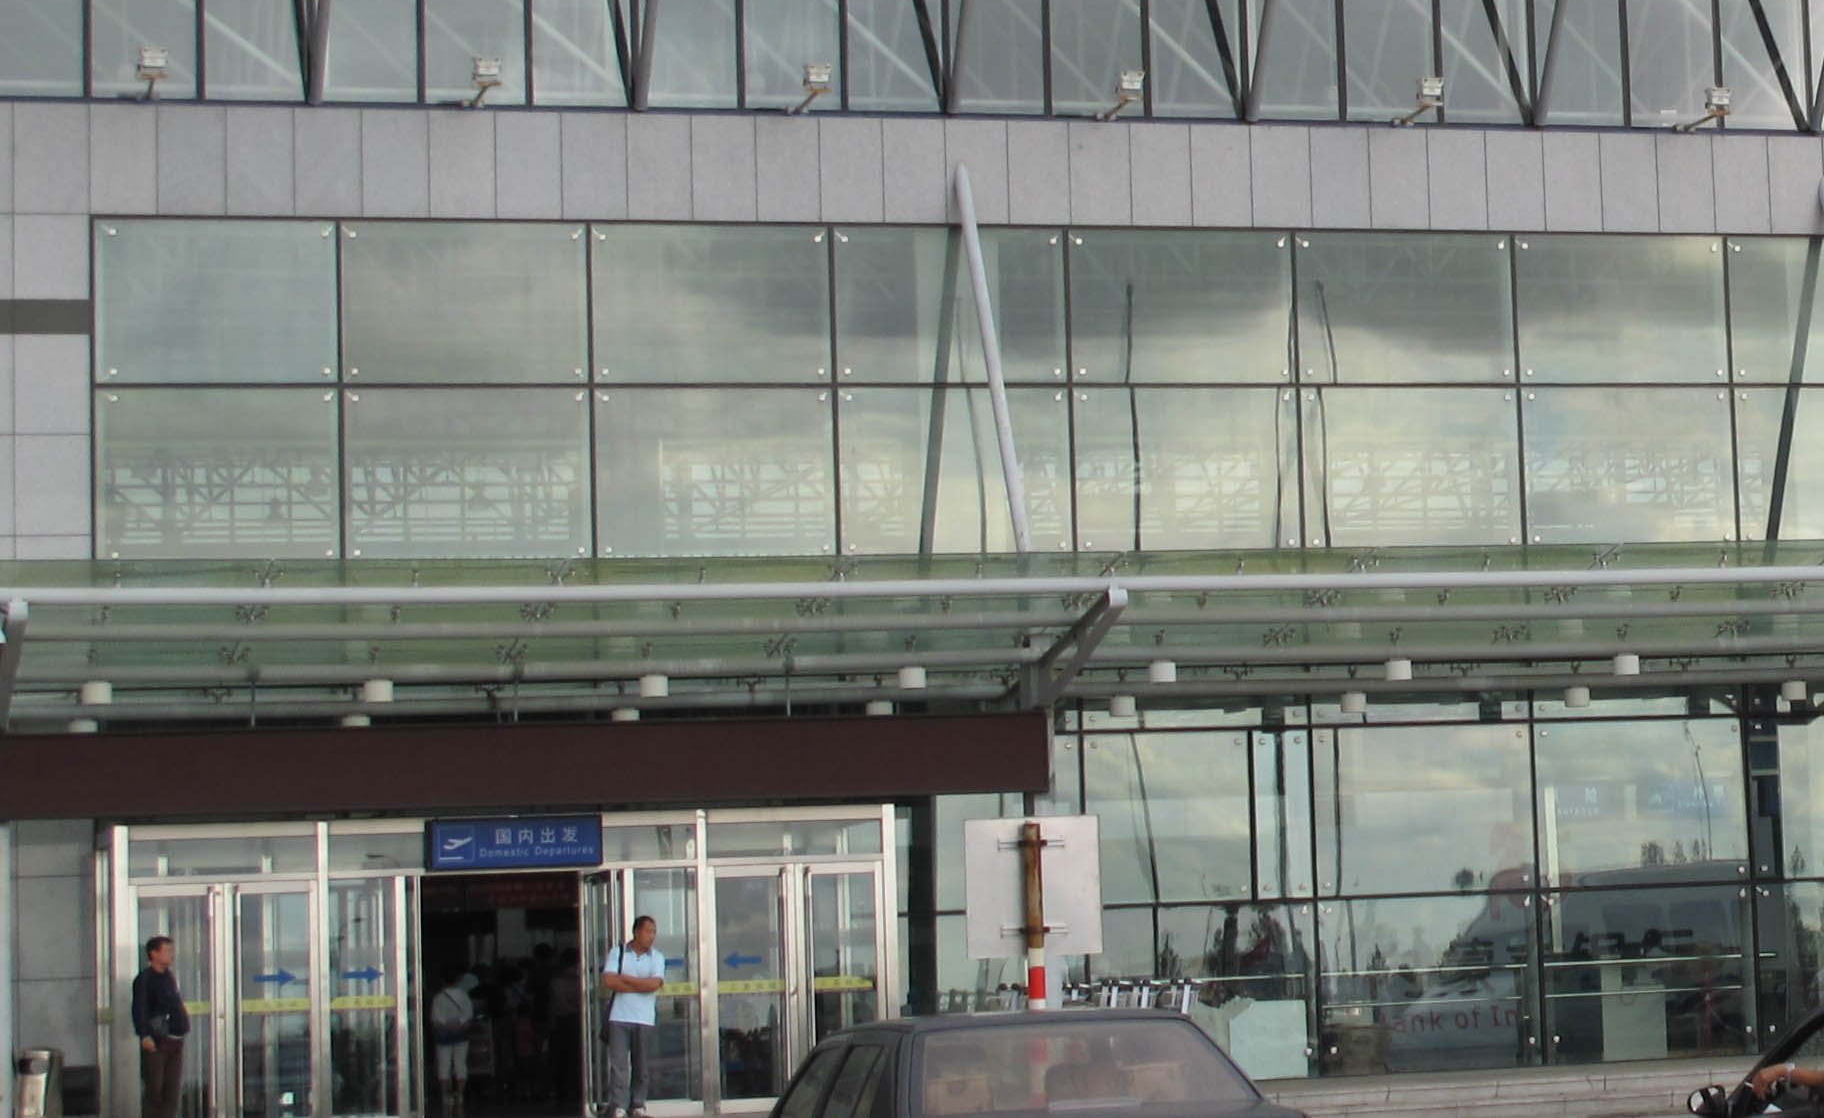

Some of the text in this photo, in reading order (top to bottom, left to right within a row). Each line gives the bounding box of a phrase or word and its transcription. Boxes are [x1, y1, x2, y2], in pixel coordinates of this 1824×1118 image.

[495, 826, 578, 845] 国内出发
[479, 844, 594, 858] Domestic Departures
